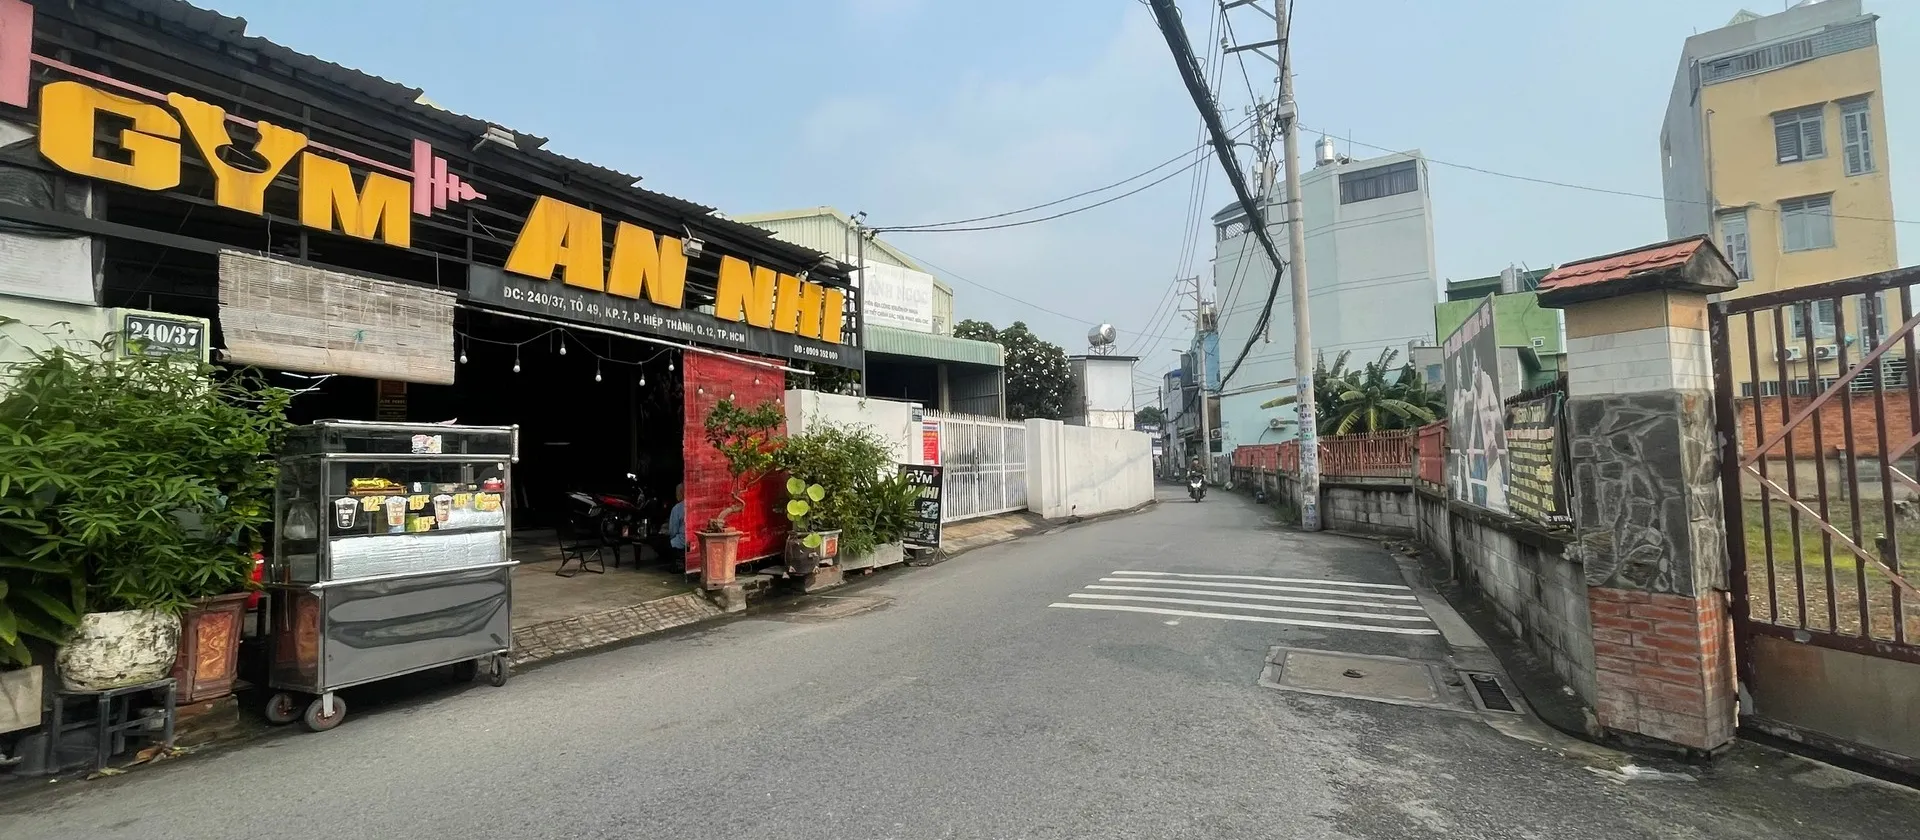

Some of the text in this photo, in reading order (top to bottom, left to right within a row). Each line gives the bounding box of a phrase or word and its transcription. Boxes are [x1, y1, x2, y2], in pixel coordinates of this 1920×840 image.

[39, 80, 844, 344] GYM AN NHI
[503, 286, 524, 301] ĐC:
[527, 290, 567, 312] 240/37,
[569, 295, 584, 312] TỔ
[586, 302, 602, 318] 49,
[665, 318, 696, 336] THÀNH,
[130, 321, 199, 346] 240/37
[806, 346, 819, 357] 0909
